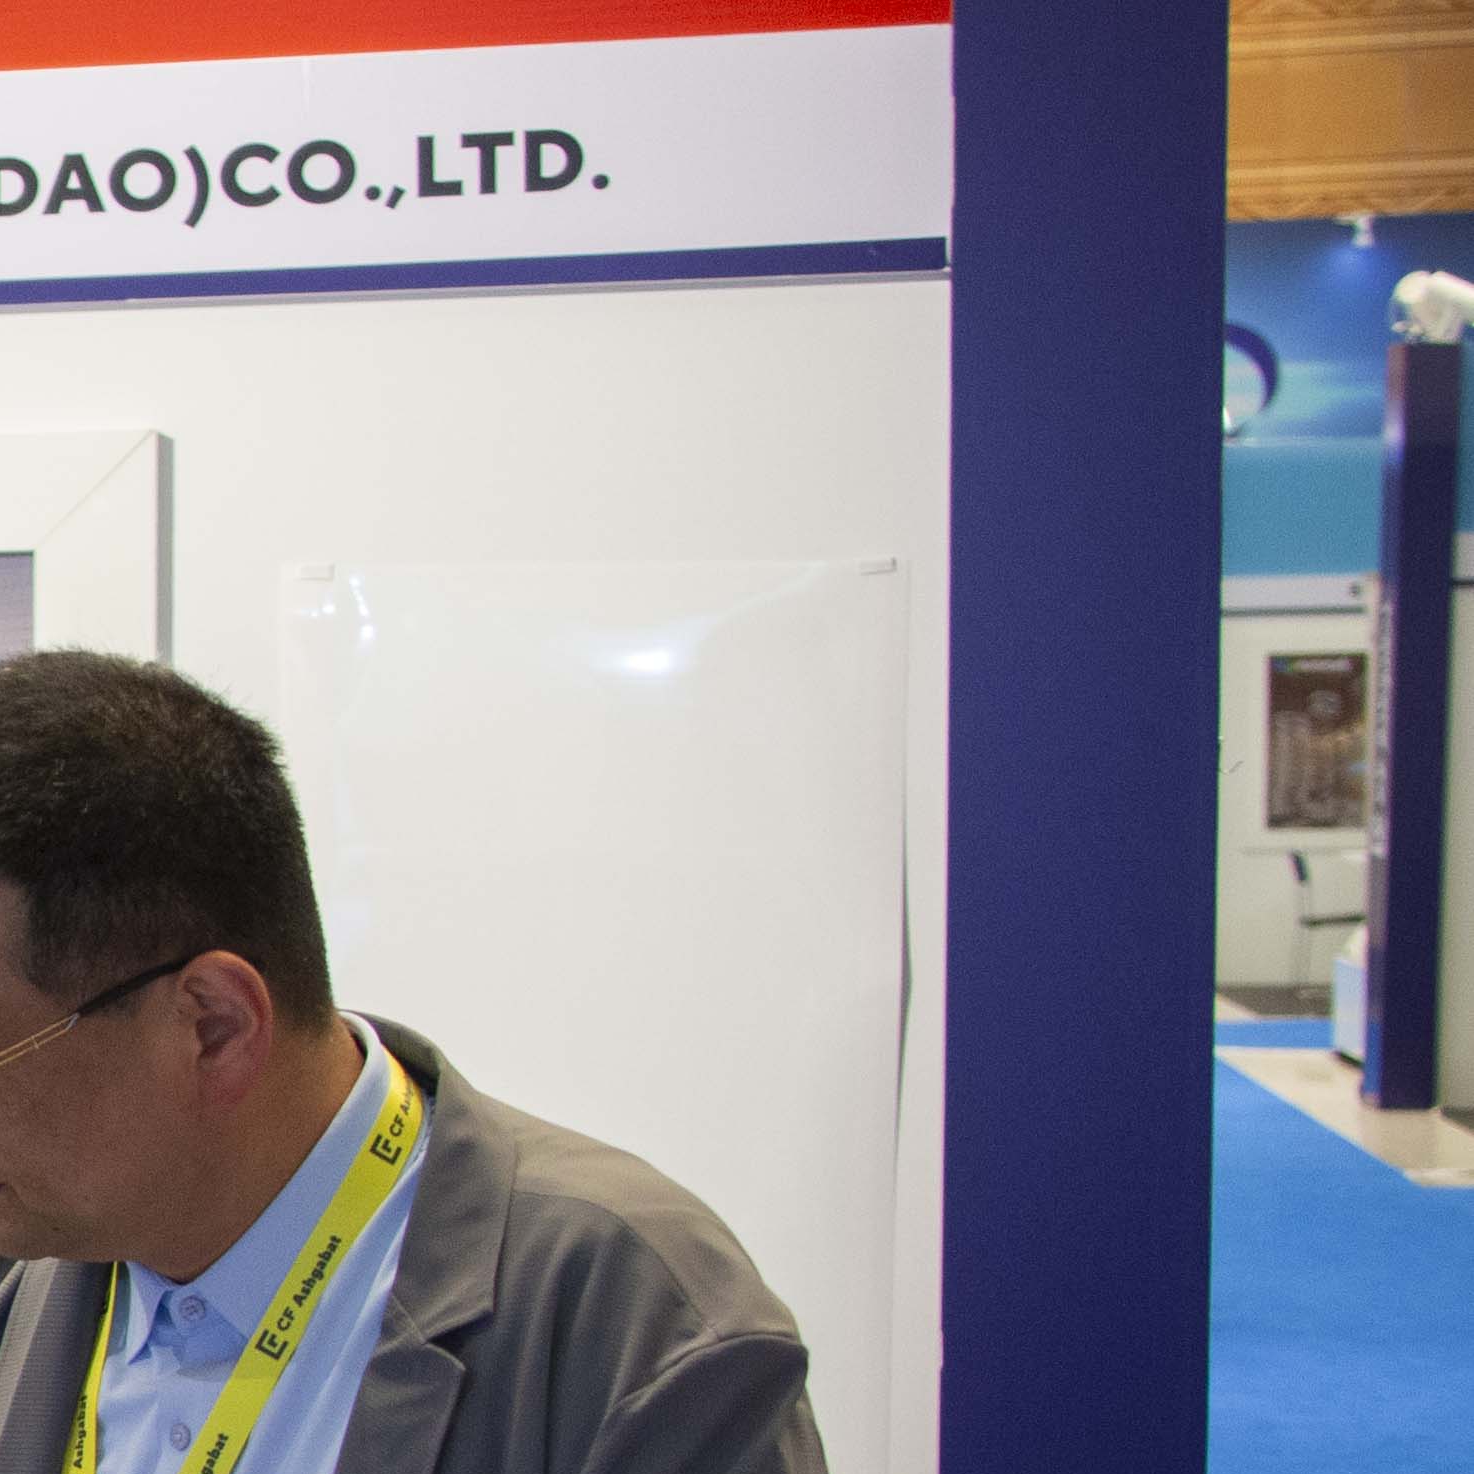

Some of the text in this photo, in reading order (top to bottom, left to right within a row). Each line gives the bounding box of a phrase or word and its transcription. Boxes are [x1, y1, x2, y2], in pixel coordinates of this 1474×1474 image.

[388, 1113, 405, 1138] CF
[276, 1234, 342, 1332] CF Ashgabat
